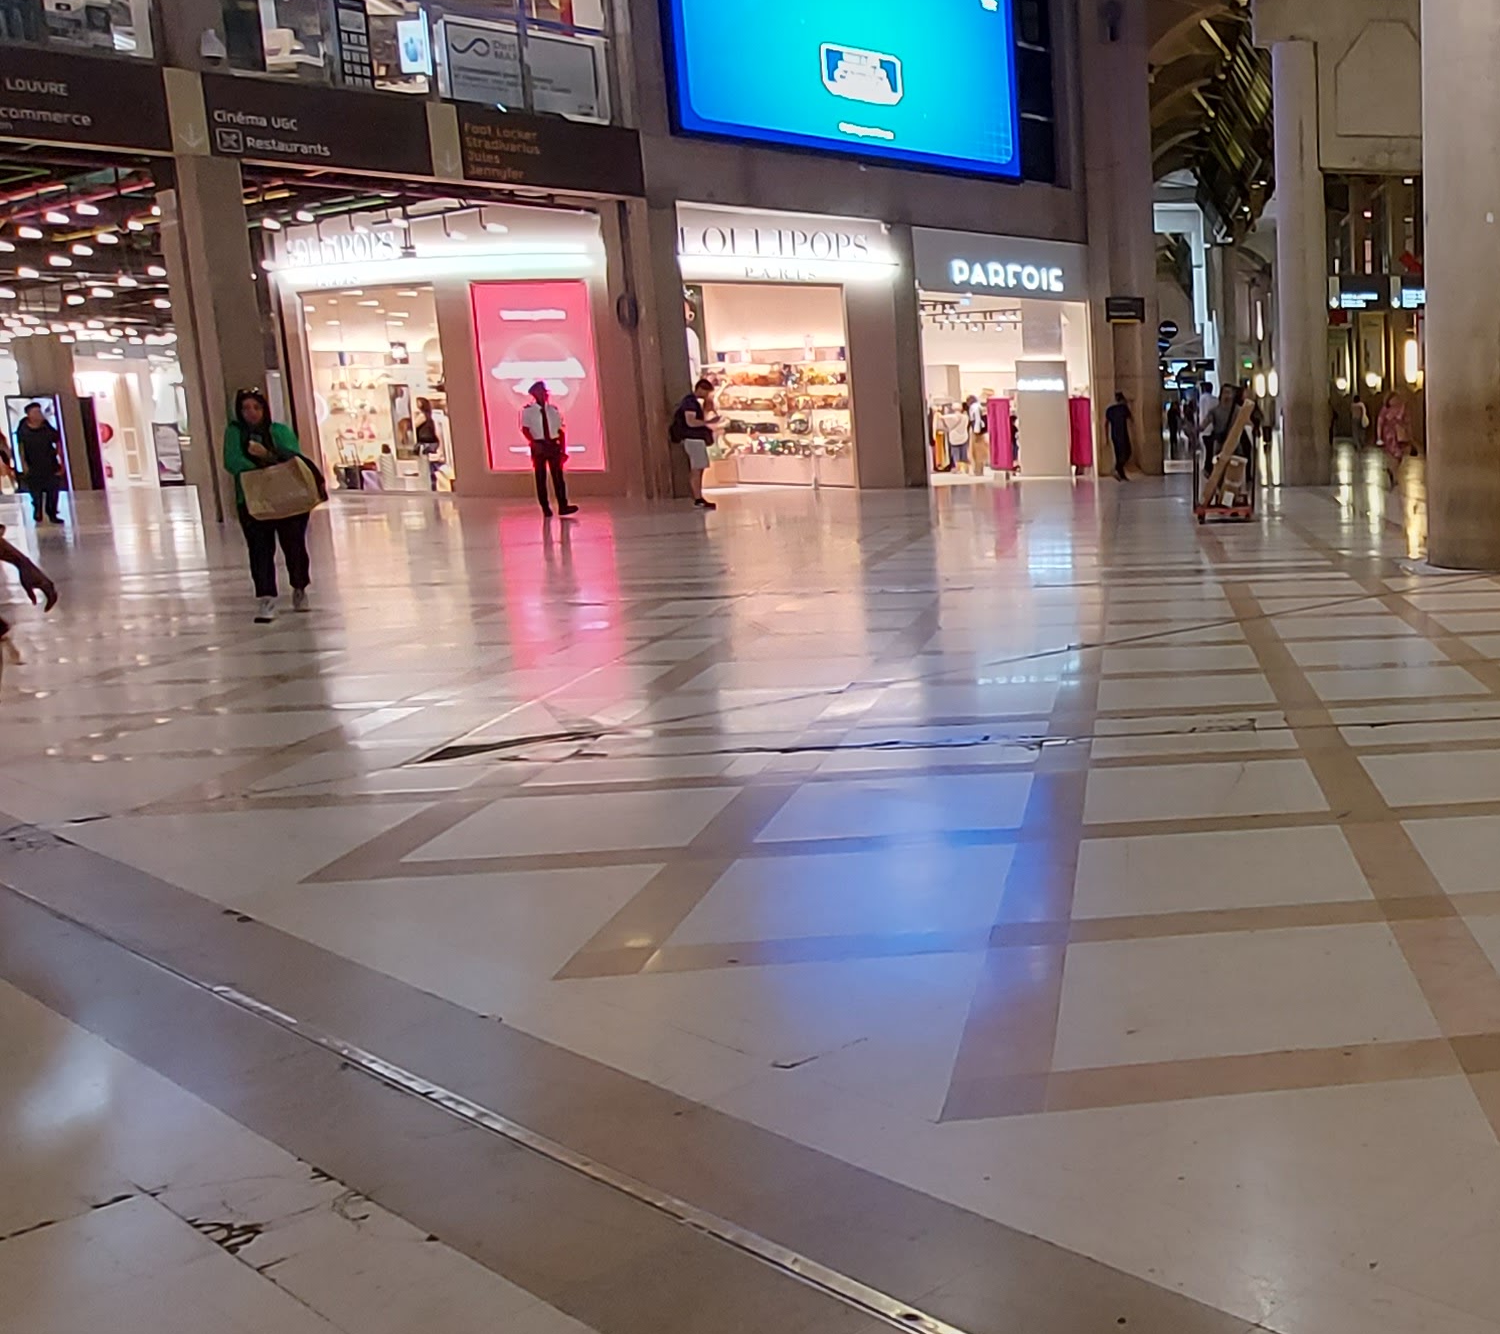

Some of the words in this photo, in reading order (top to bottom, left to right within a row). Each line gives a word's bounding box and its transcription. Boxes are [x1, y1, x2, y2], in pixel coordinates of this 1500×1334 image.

[5, 78, 68, 96] LOUVRE
[213, 110, 267, 127] Cinéma
[271, 116, 298, 131] UGC
[246, 136, 331, 157] Restaurants
[680, 226, 868, 259] LOLLIPOPS
[744, 266, 816, 281] PARIS
[950, 259, 1064, 292] PARFOIS
